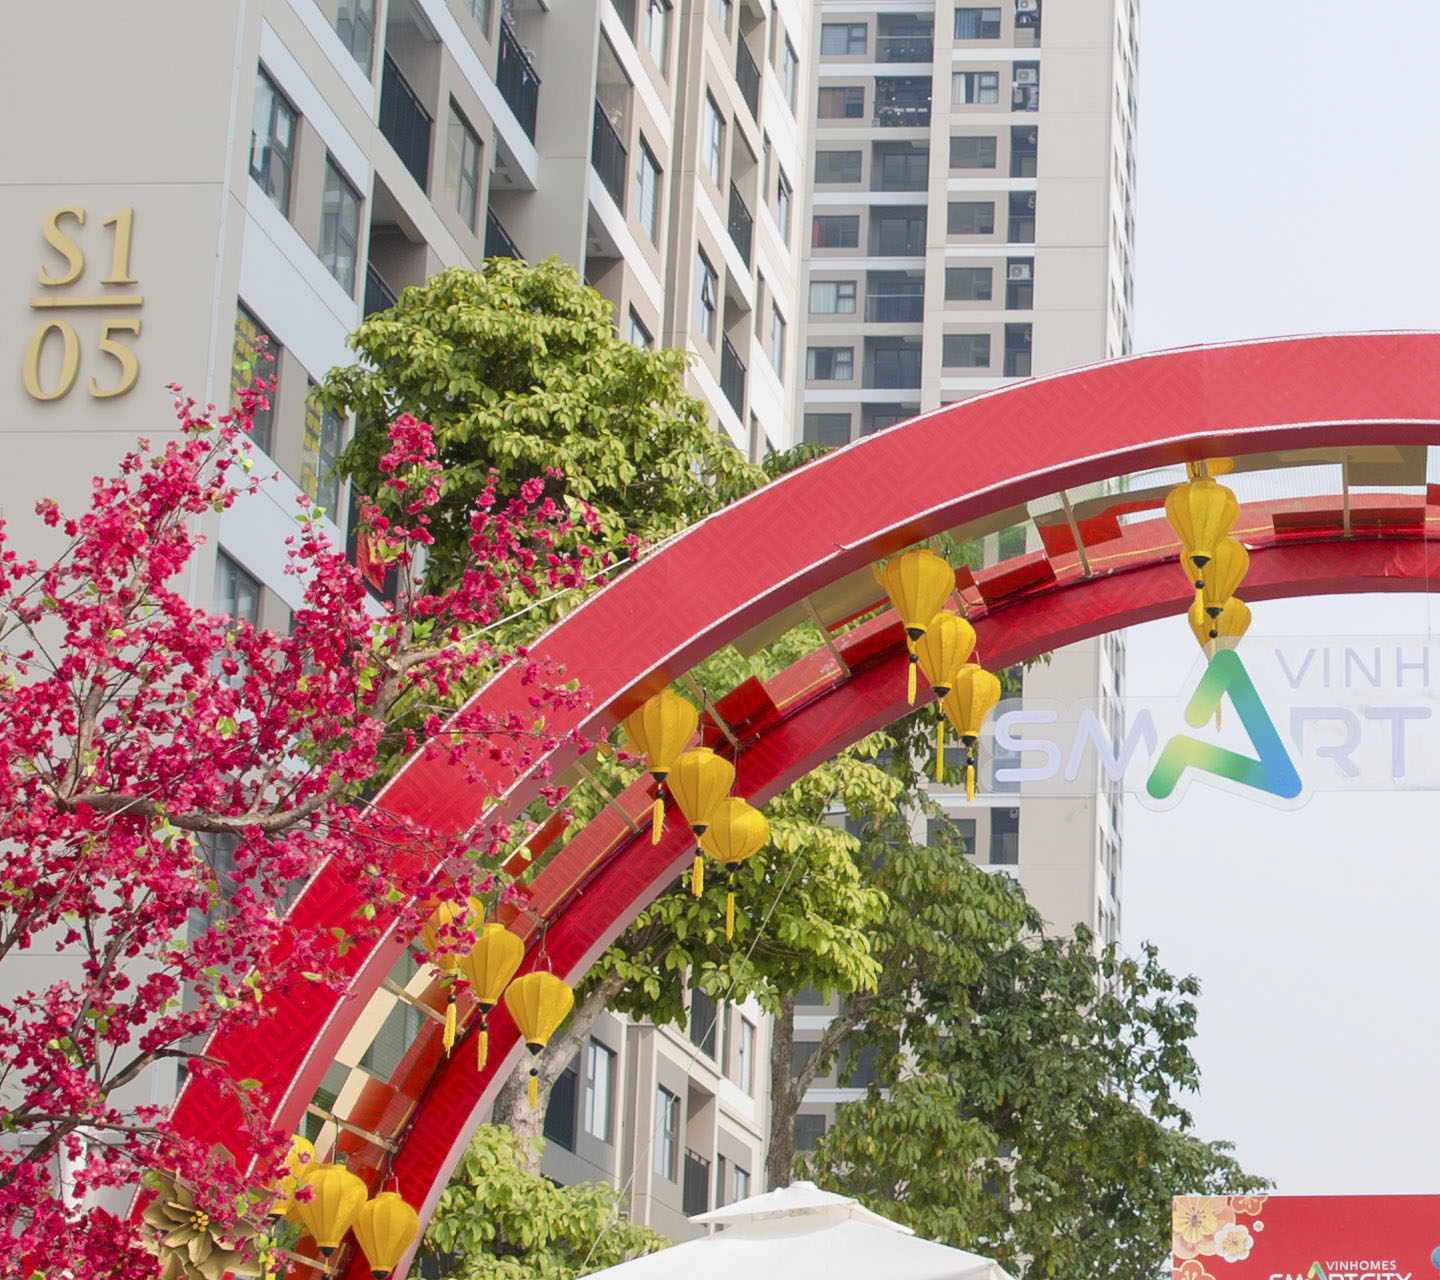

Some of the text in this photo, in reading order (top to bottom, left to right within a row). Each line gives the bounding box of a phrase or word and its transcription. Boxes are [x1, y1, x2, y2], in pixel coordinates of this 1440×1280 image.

[37, 206, 139, 287] S1
[22, 318, 142, 402] 05
[1325, 1260, 1398, 1271] VINHOMES
